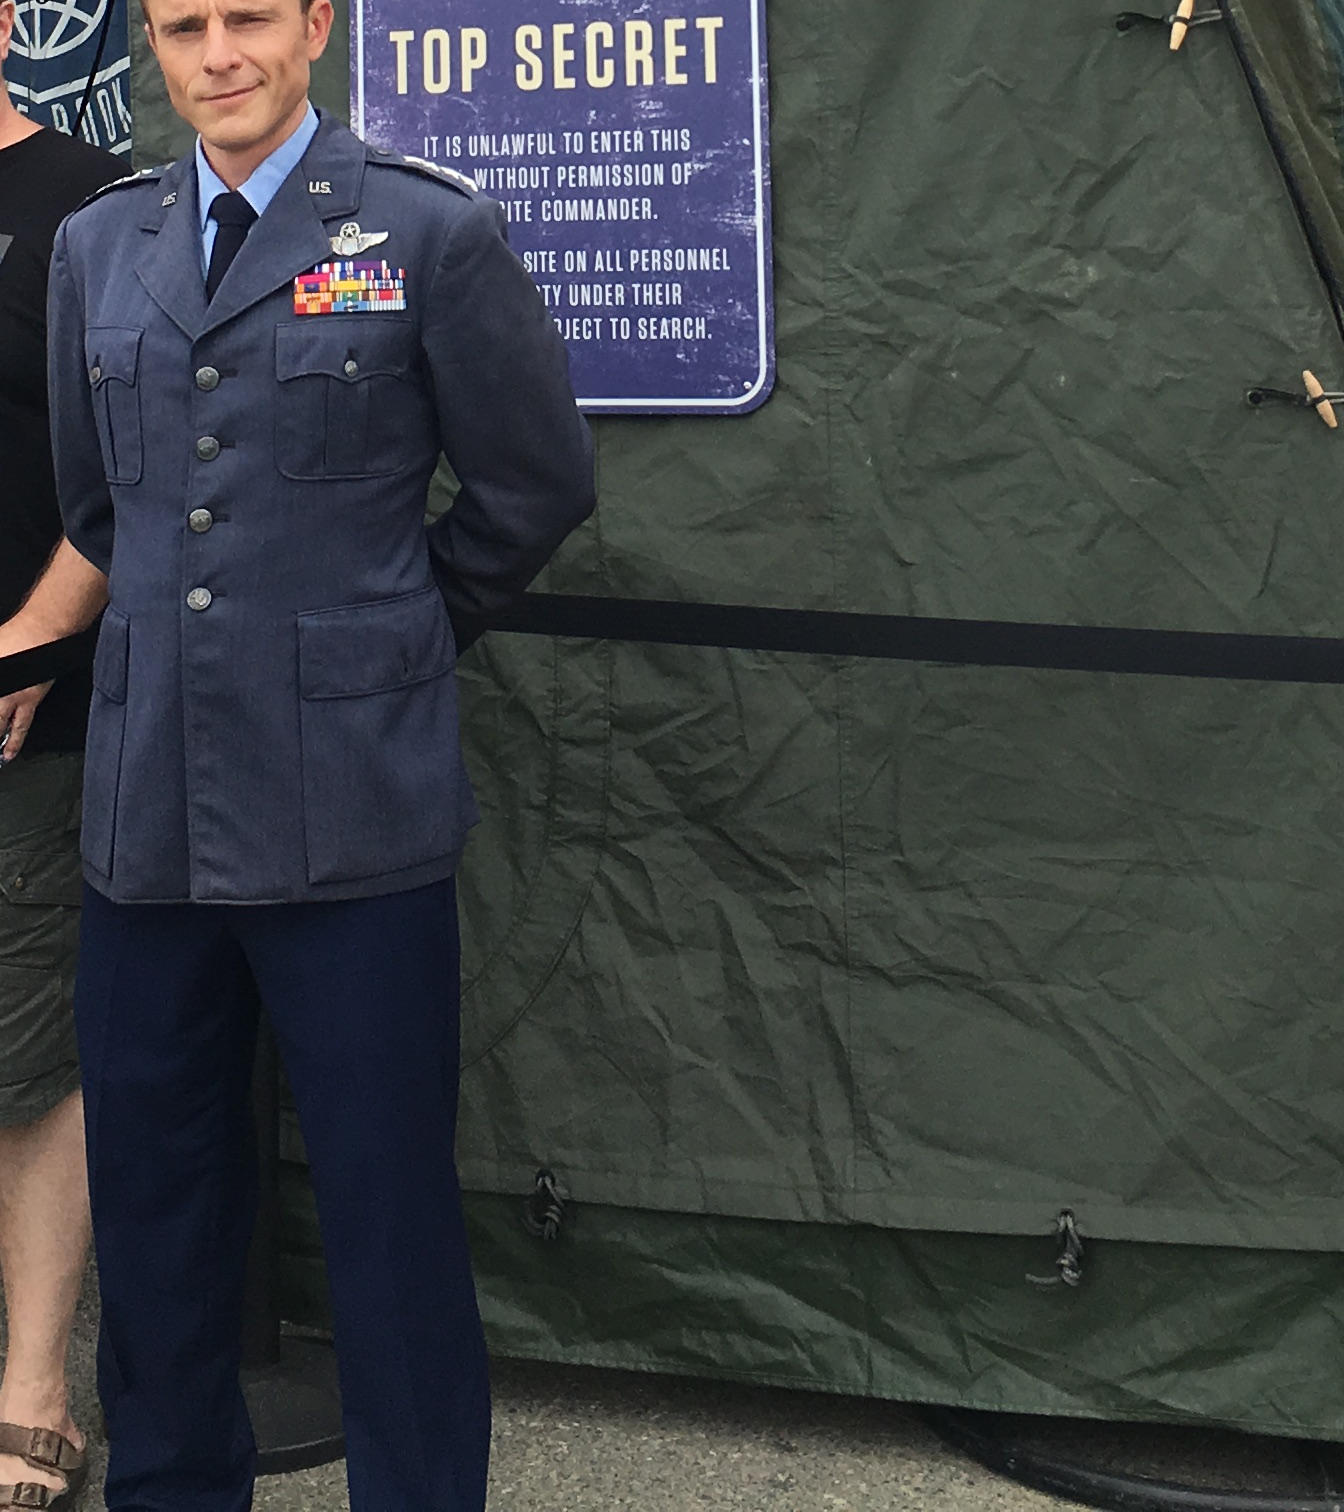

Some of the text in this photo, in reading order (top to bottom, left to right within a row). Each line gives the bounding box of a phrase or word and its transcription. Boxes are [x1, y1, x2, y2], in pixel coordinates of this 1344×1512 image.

[389, 16, 724, 95] TOP SECRET
[424, 129, 690, 158] IT IS UNLAWFUL TO ENTER THIS
[474, 163, 693, 189] WITHOUT PERMISSION OF
[542, 198, 658, 221] COMMANDER.
[523, 248, 731, 273] SITE ON ALL PERSONNEL
[569, 284, 625, 306] UNDER
[632, 283, 682, 305] THEIR
[610, 317, 630, 340] TO
[638, 316, 713, 340] SEARCH.
